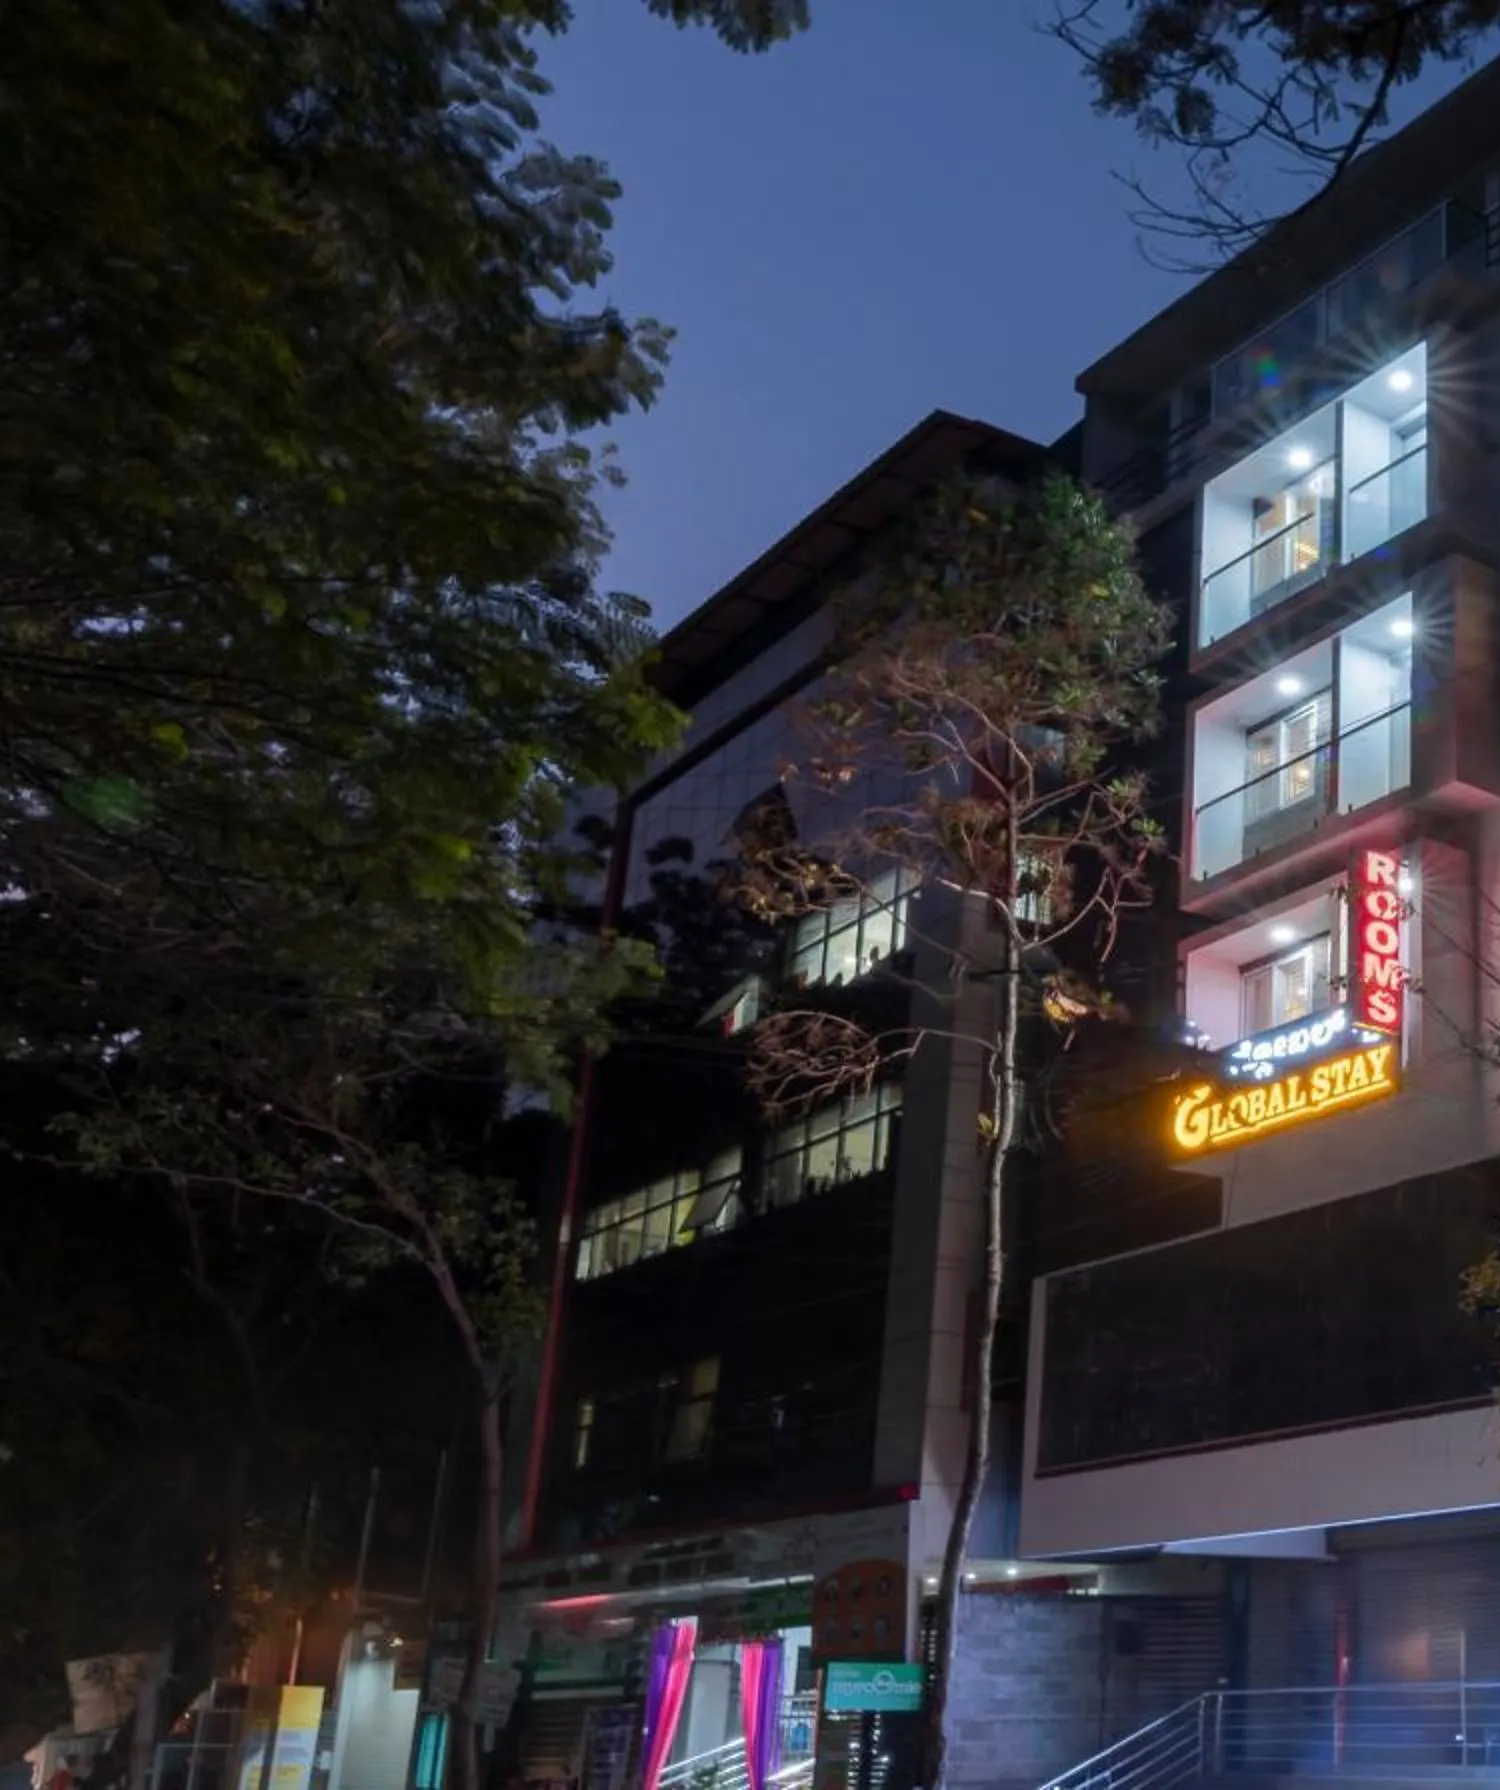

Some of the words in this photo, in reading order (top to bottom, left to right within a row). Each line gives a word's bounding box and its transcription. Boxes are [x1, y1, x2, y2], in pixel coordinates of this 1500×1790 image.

[1364, 851, 1399, 1023] ROOMS
[1174, 1076, 1306, 1148] GLOBAL
[1311, 1045, 1391, 1101] STAY
